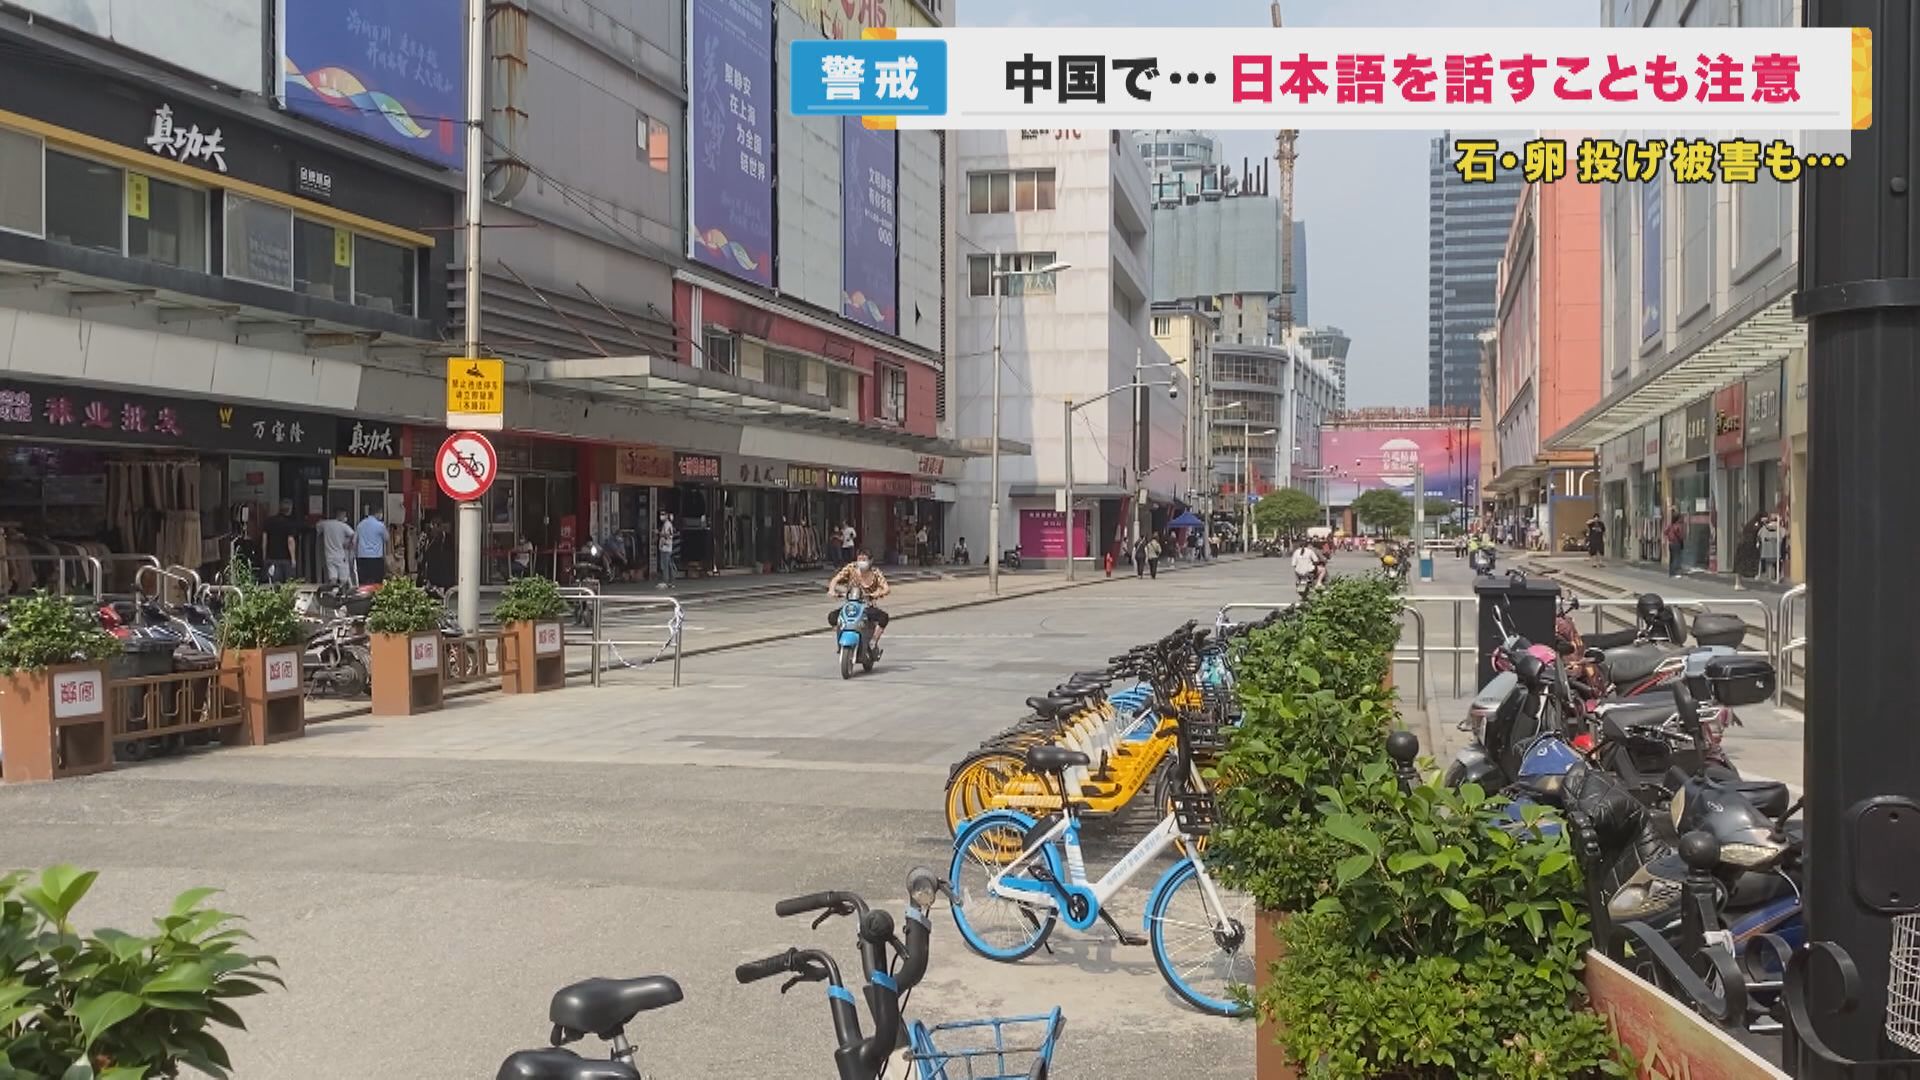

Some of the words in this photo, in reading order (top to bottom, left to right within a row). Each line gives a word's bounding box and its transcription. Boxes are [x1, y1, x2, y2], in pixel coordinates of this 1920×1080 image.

[729, 93, 757, 127] 在上海
[144, 103, 227, 173] 真功夫
[252, 420, 305, 443] 万宝隆
[348, 421, 393, 456] 真功夫
